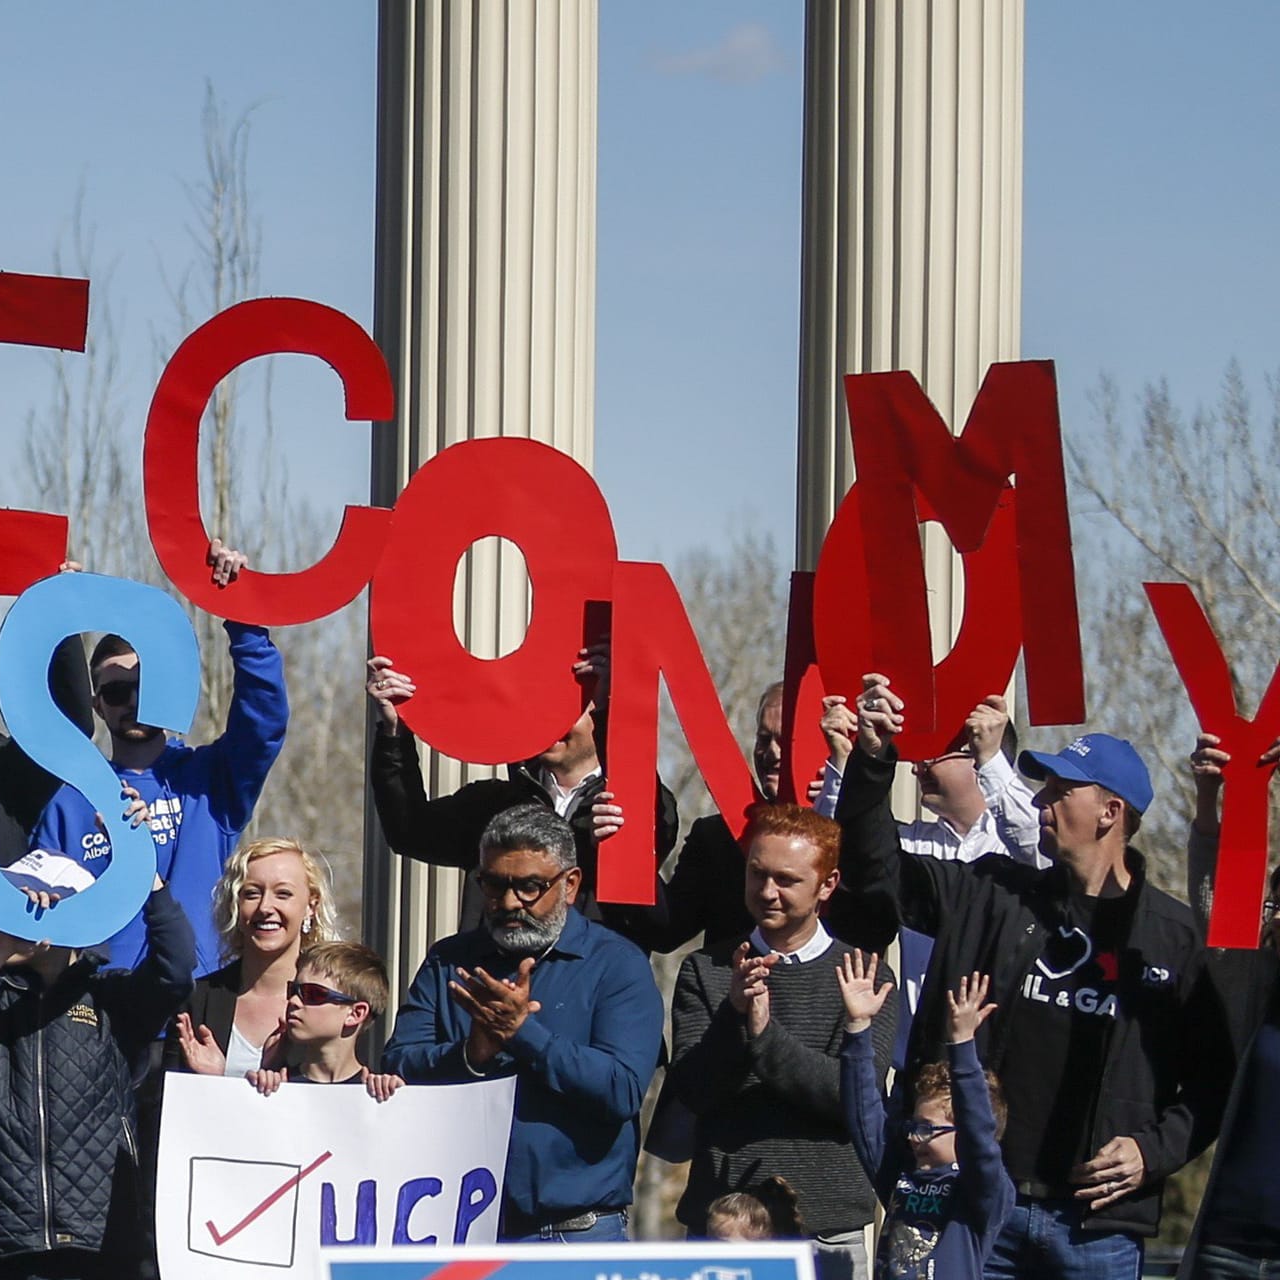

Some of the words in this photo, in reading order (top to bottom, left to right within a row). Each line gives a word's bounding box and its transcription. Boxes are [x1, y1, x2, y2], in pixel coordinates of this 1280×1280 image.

[83, 846, 110, 862] Albe
[1020, 974, 1050, 1003] IL
[1055, 990, 1070, 1007] &
[321, 1166, 498, 1247] UCP
